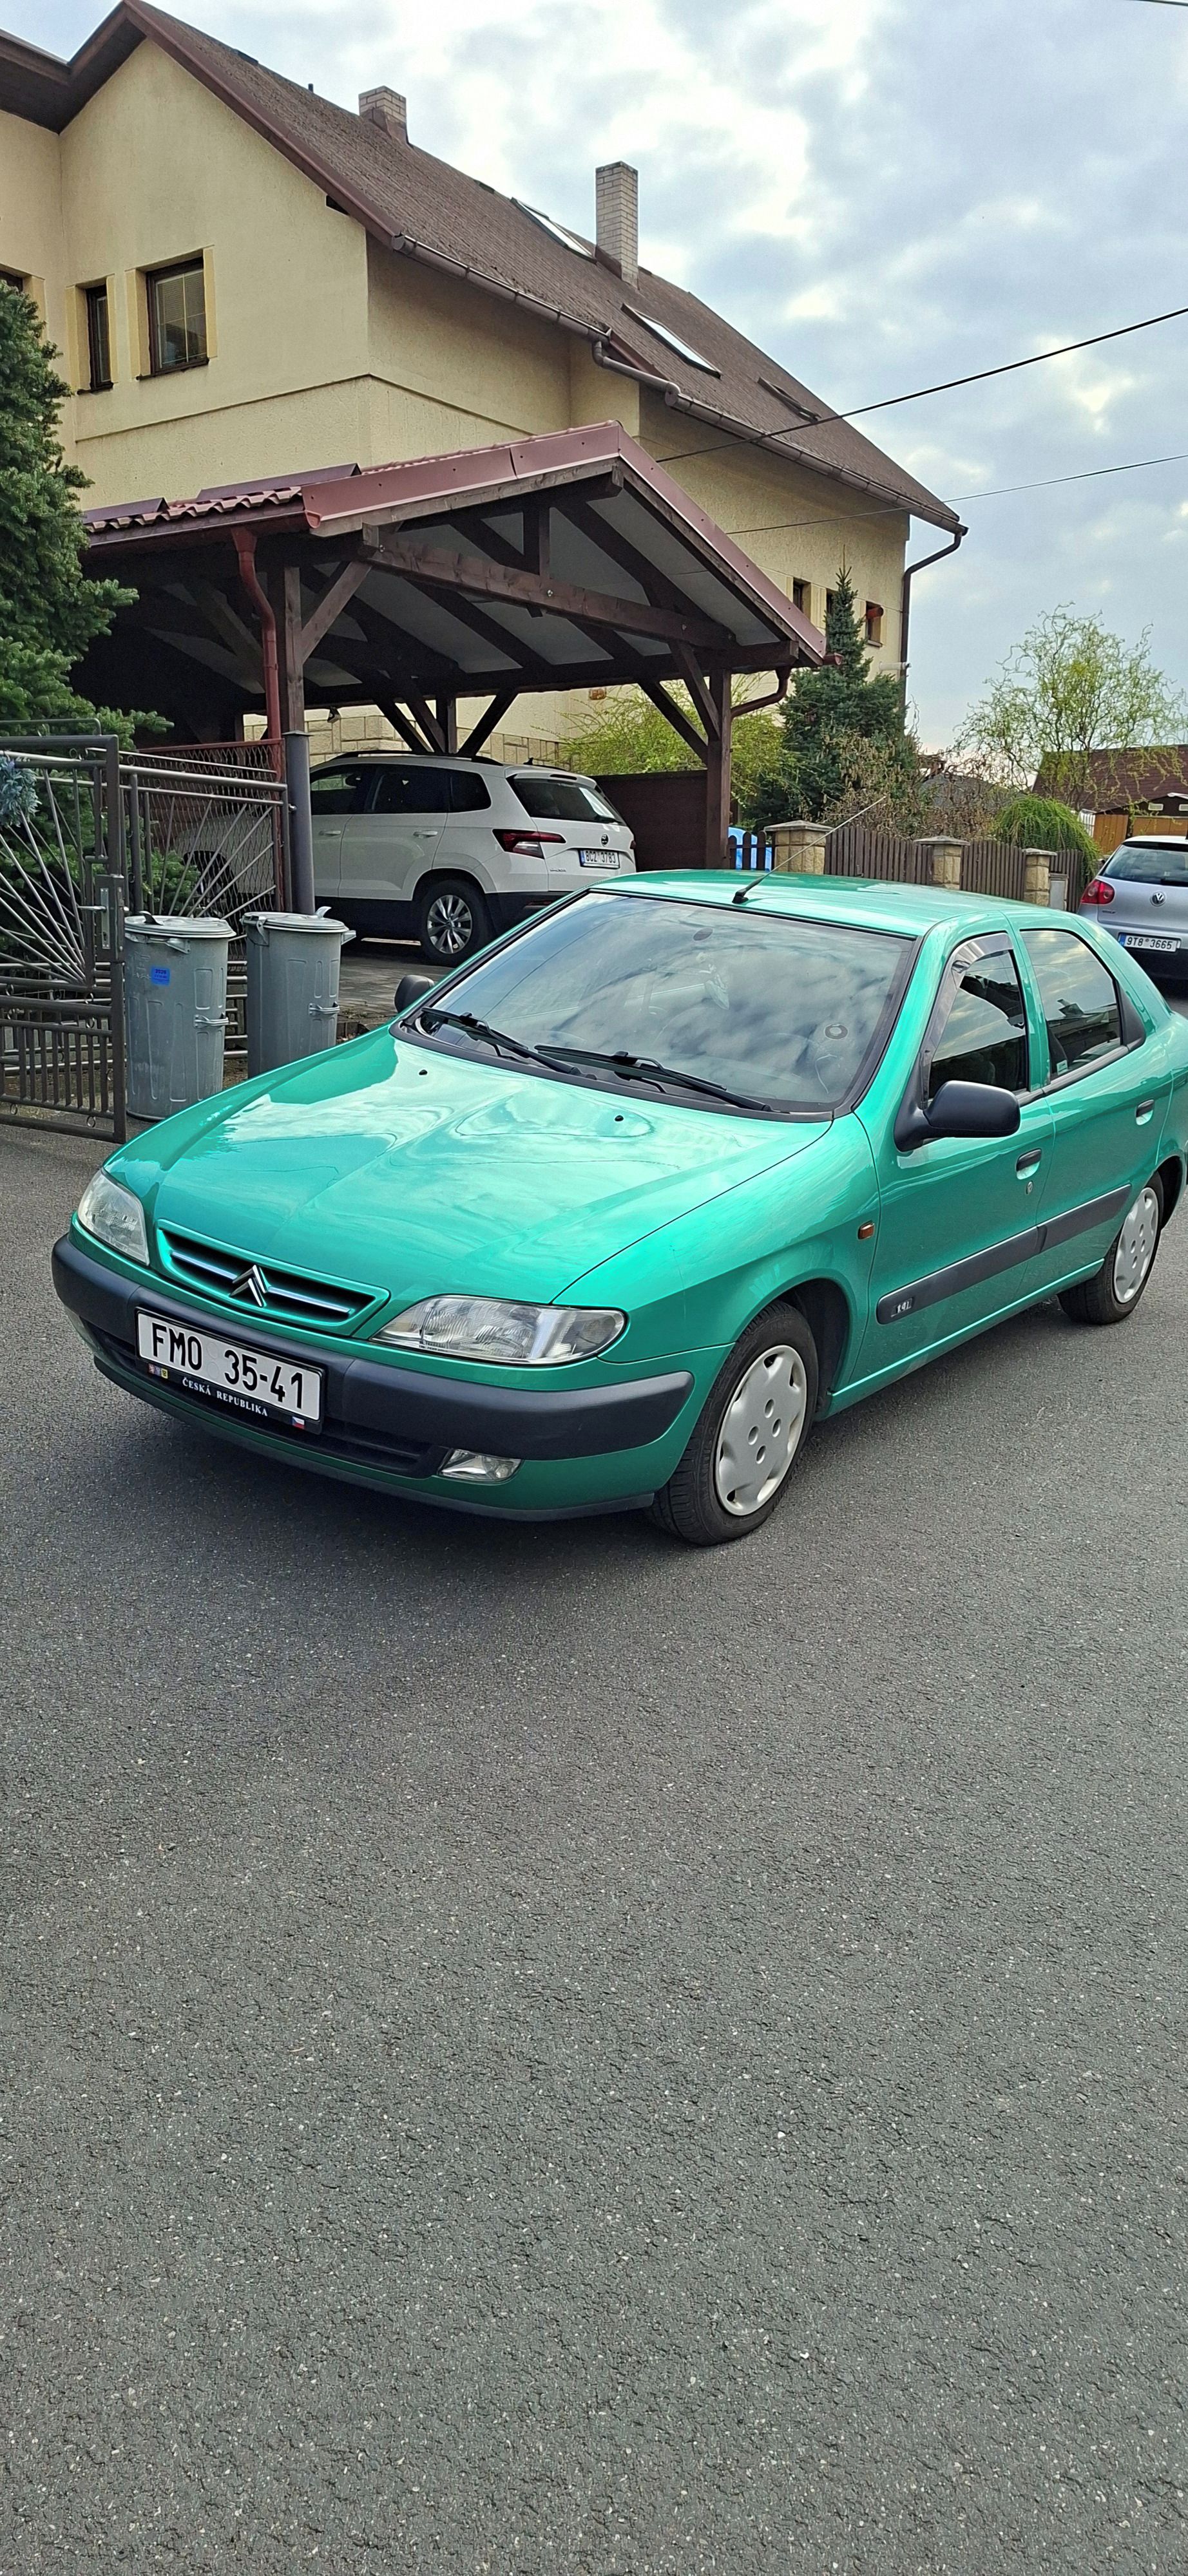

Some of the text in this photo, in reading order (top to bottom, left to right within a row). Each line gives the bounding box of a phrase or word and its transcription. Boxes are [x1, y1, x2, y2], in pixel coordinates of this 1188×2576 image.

[585, 850, 616, 864] 8C2 3783
[1126, 936, 1173, 950] 9T8 3665
[151, 1322, 303, 1409] FMO 35-41
[182, 1377, 268, 1417] ČESKÁ REPUBLIKA
